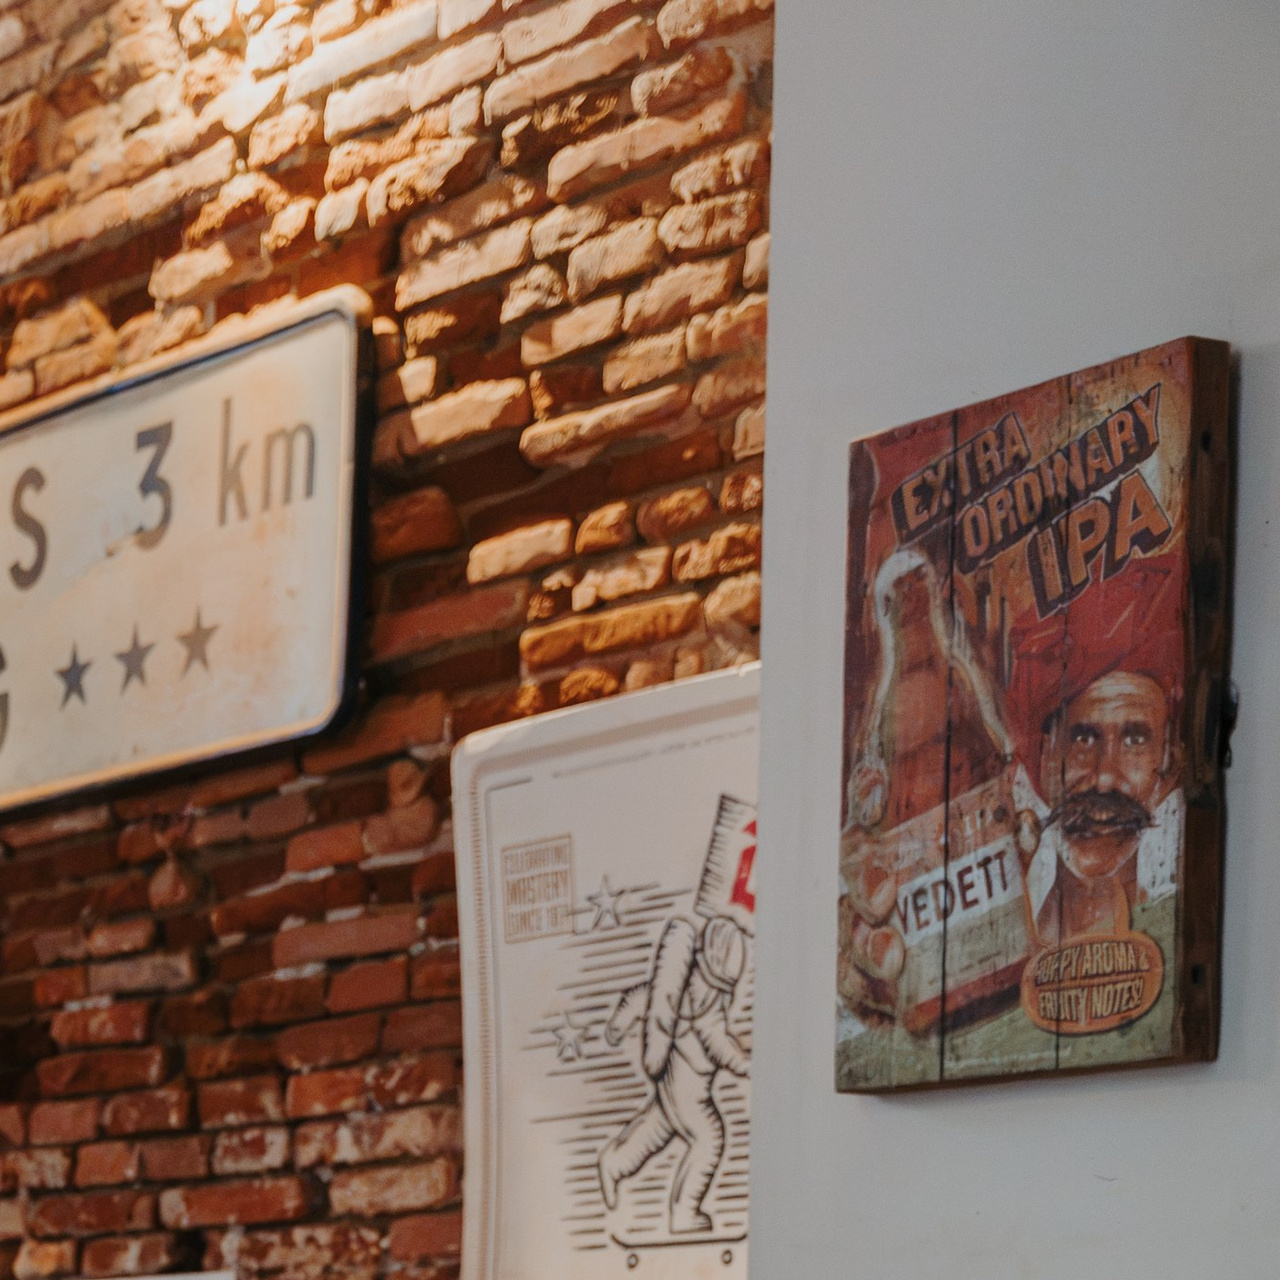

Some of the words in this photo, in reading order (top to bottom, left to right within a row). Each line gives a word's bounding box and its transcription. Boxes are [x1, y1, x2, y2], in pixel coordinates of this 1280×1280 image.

[129, 421, 175, 549] 3
[216, 398, 317, 528] km
[898, 413, 1030, 533] EXTRA
[961, 383, 1161, 559] ORDINARY
[1036, 470, 1171, 603] IPA
[896, 849, 1009, 935] VEDETT
[1081, 940, 1137, 977] AROMA
